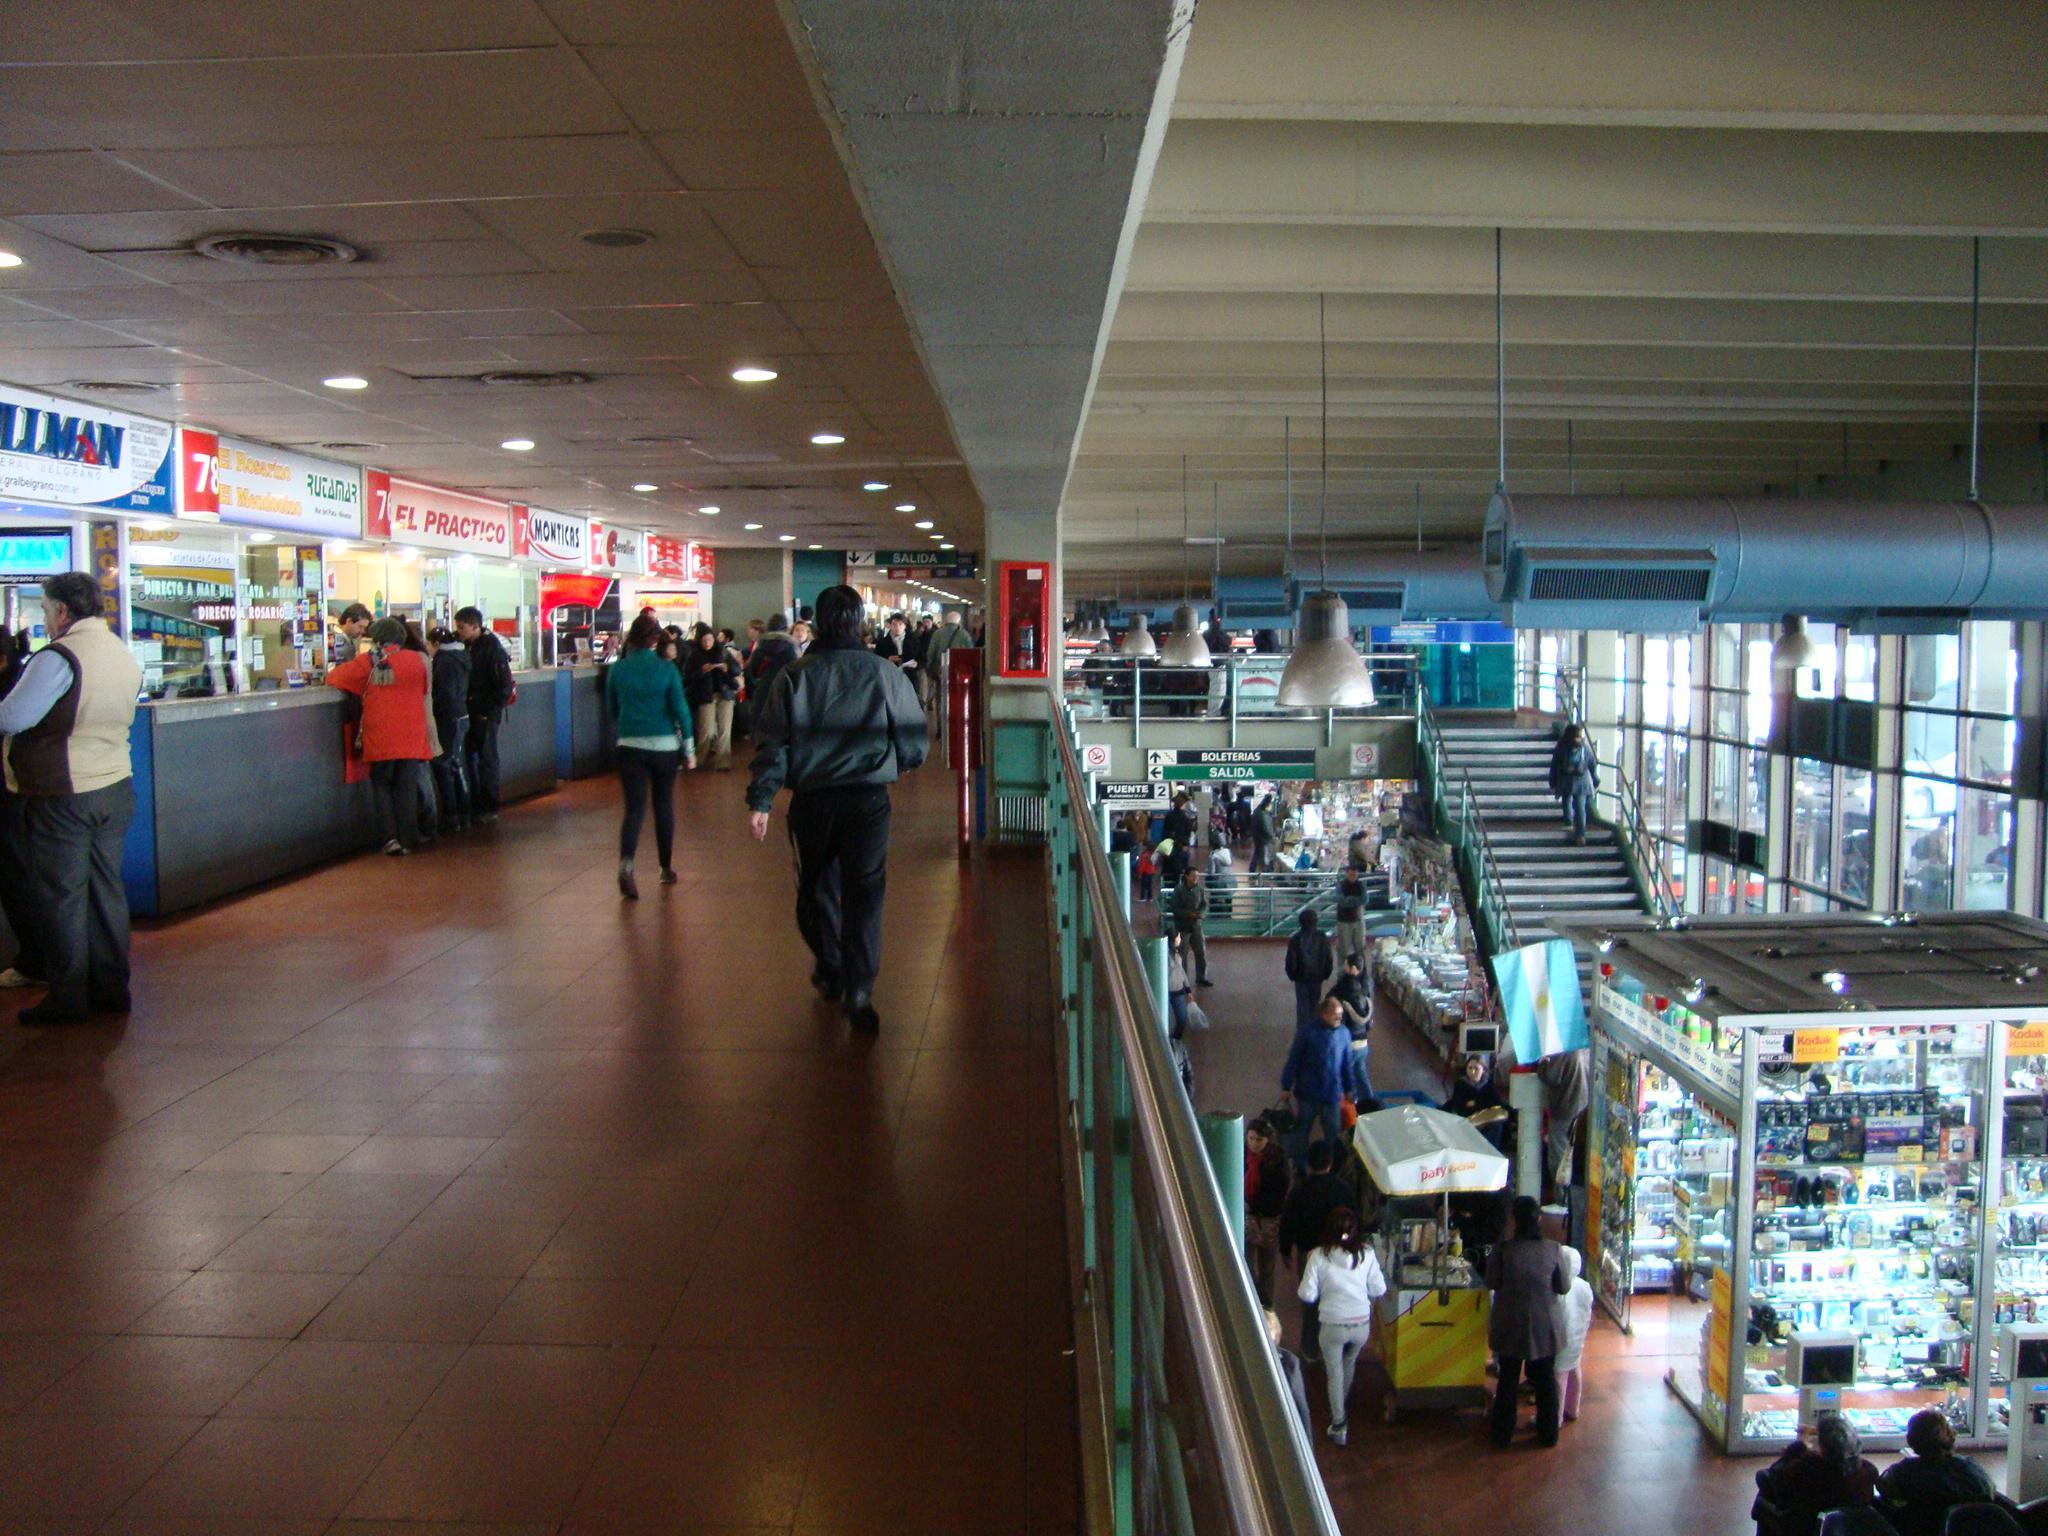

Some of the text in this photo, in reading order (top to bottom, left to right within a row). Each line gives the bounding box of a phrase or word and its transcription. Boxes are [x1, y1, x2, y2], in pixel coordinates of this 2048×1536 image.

[236, 450, 292, 482] Rosarino
[306, 473, 358, 504] RUTAMAR
[396, 505, 506, 544] EL PRACTICO
[534, 518, 580, 549] MONTICAS
[893, 552, 938, 564] SALIDA
[144, 580, 184, 595] DIRECTO
[187, 582, 193, 595] A
[197, 582, 216, 597] MAR
[239, 584, 264, 598] PLATA
[198, 605, 236, 620] DIRECTO
[248, 606, 284, 620] ROSARIO
[1201, 751, 1261, 762] BOLETERIAS
[1209, 766, 1255, 778] SALIDA
[1106, 784, 1149, 794] PUENTE
[1157, 785, 1166, 797] 2
[1797, 1034, 1832, 1046] Kodak
[2009, 1029, 2044, 1040] Kodak
[1420, 1165, 1447, 1183] paty
